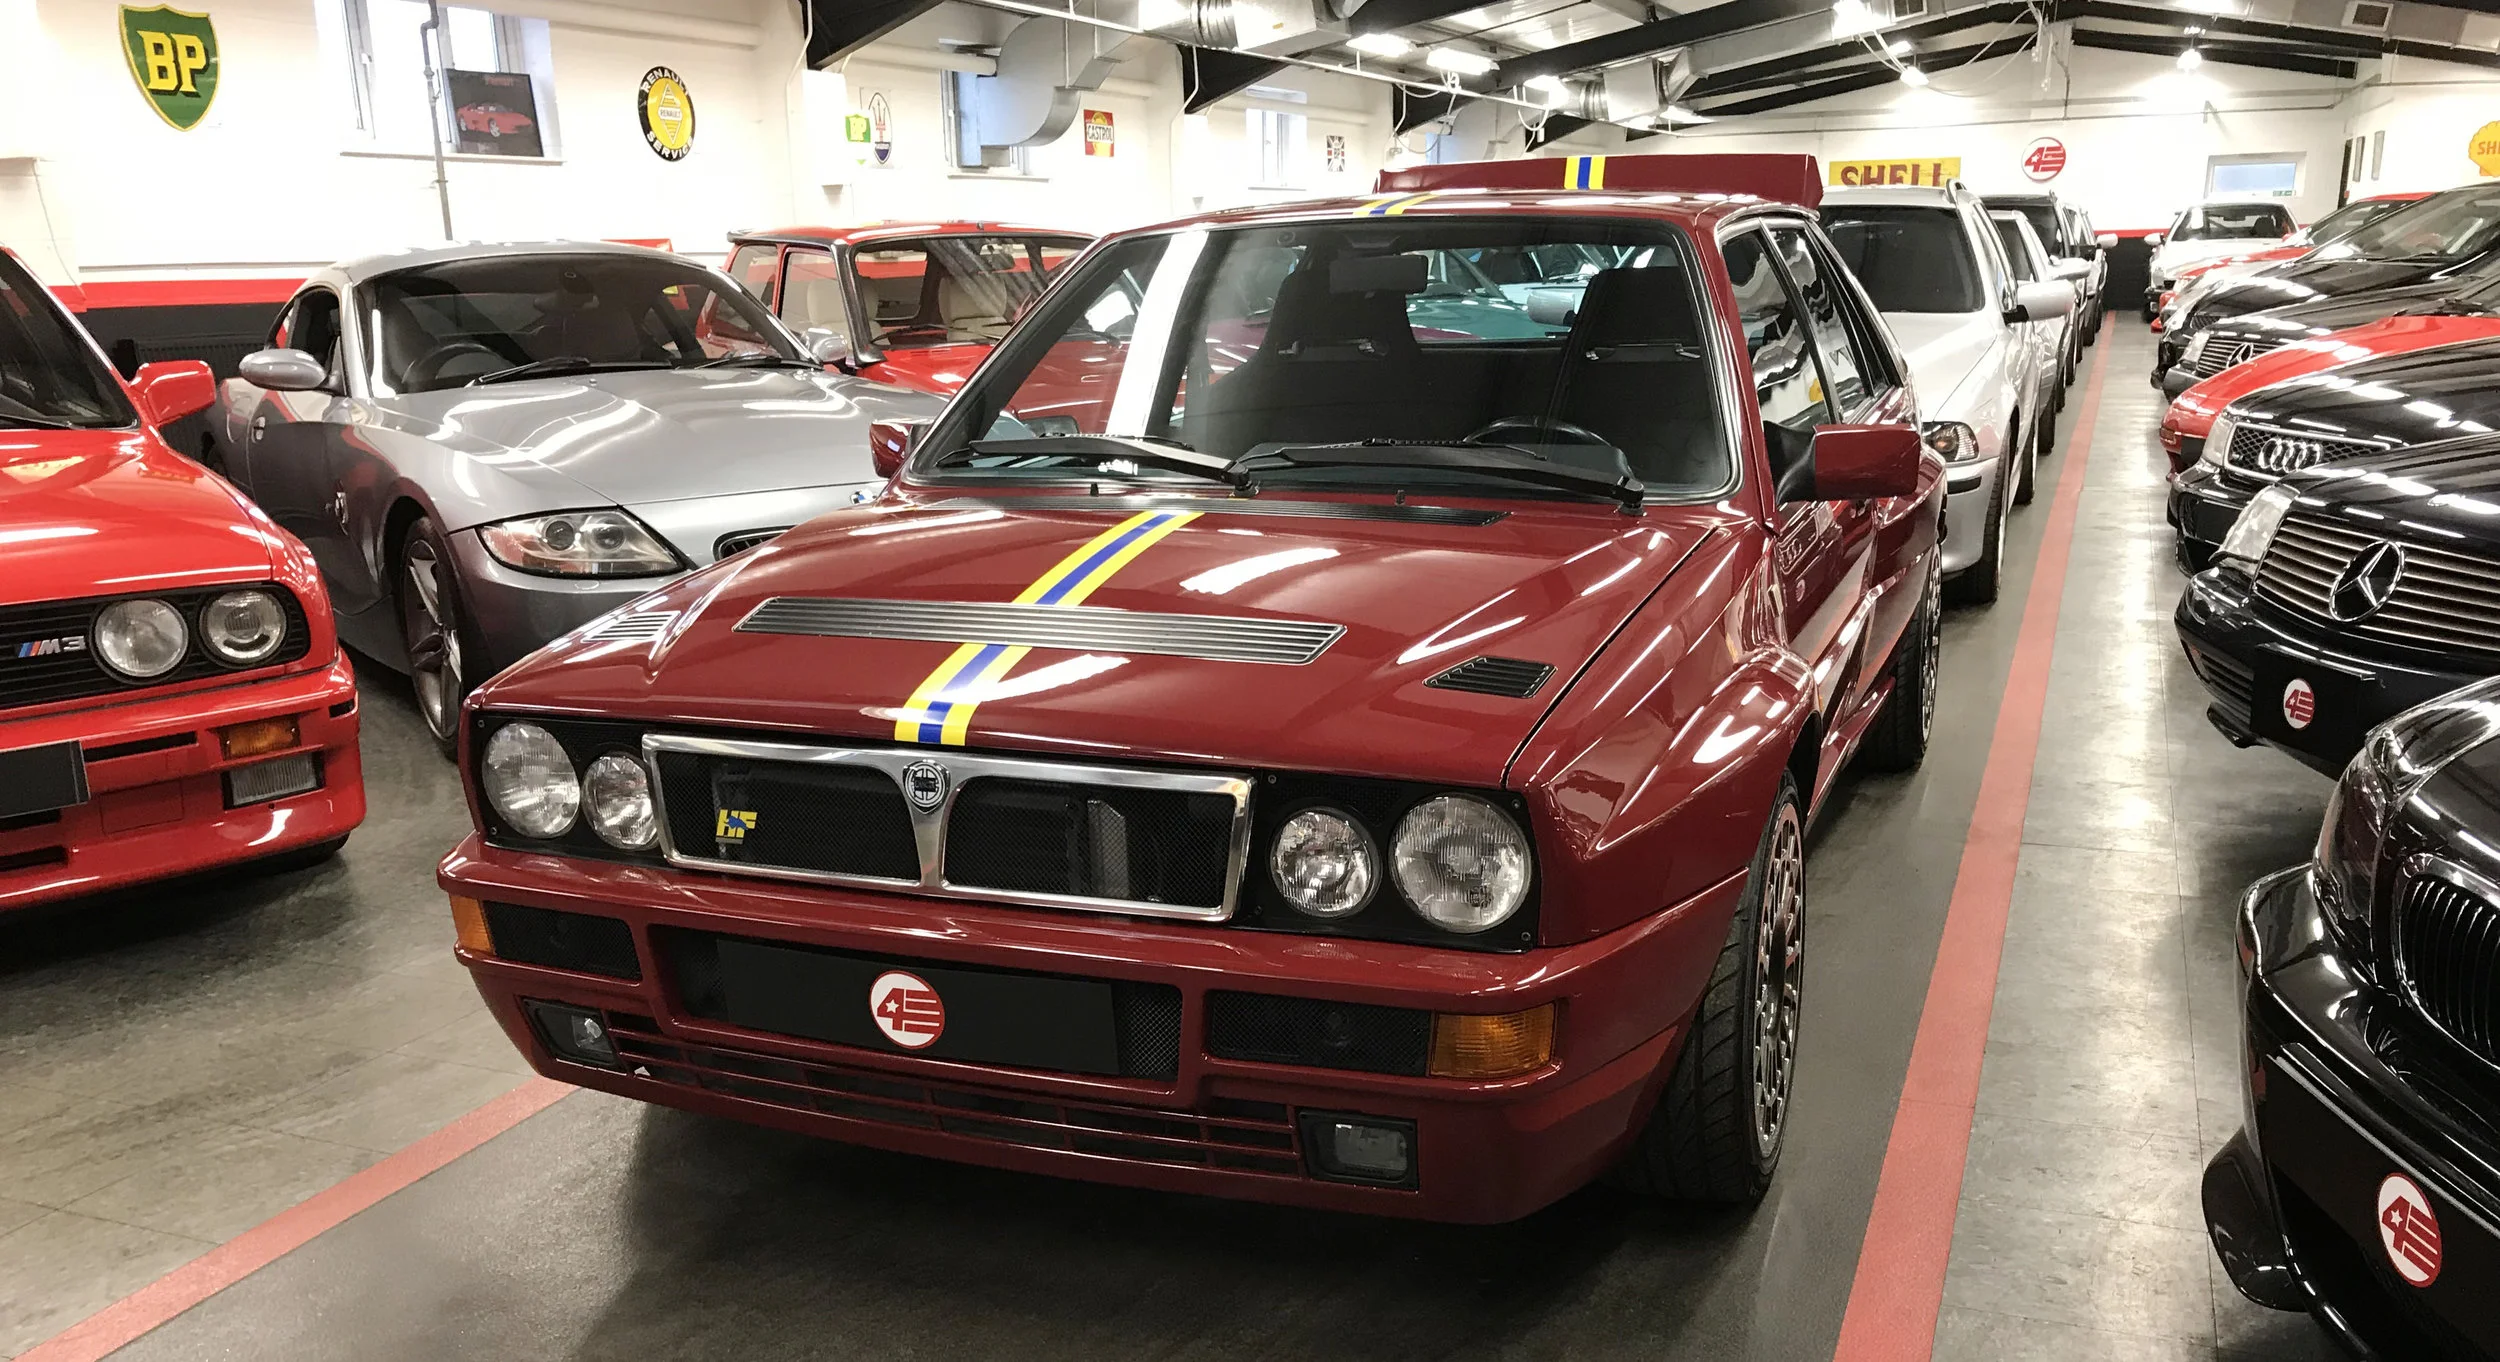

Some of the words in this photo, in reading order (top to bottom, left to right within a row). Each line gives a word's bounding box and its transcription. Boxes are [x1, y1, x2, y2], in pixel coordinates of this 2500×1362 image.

[136, 30, 208, 96] BP
[640, 68, 690, 96] RENAULT
[646, 130, 694, 159] SERVICE
[1087, 124, 1113, 142] CASTROL
[2477, 140, 2500, 156] SH
[716, 809, 758, 838] HF
